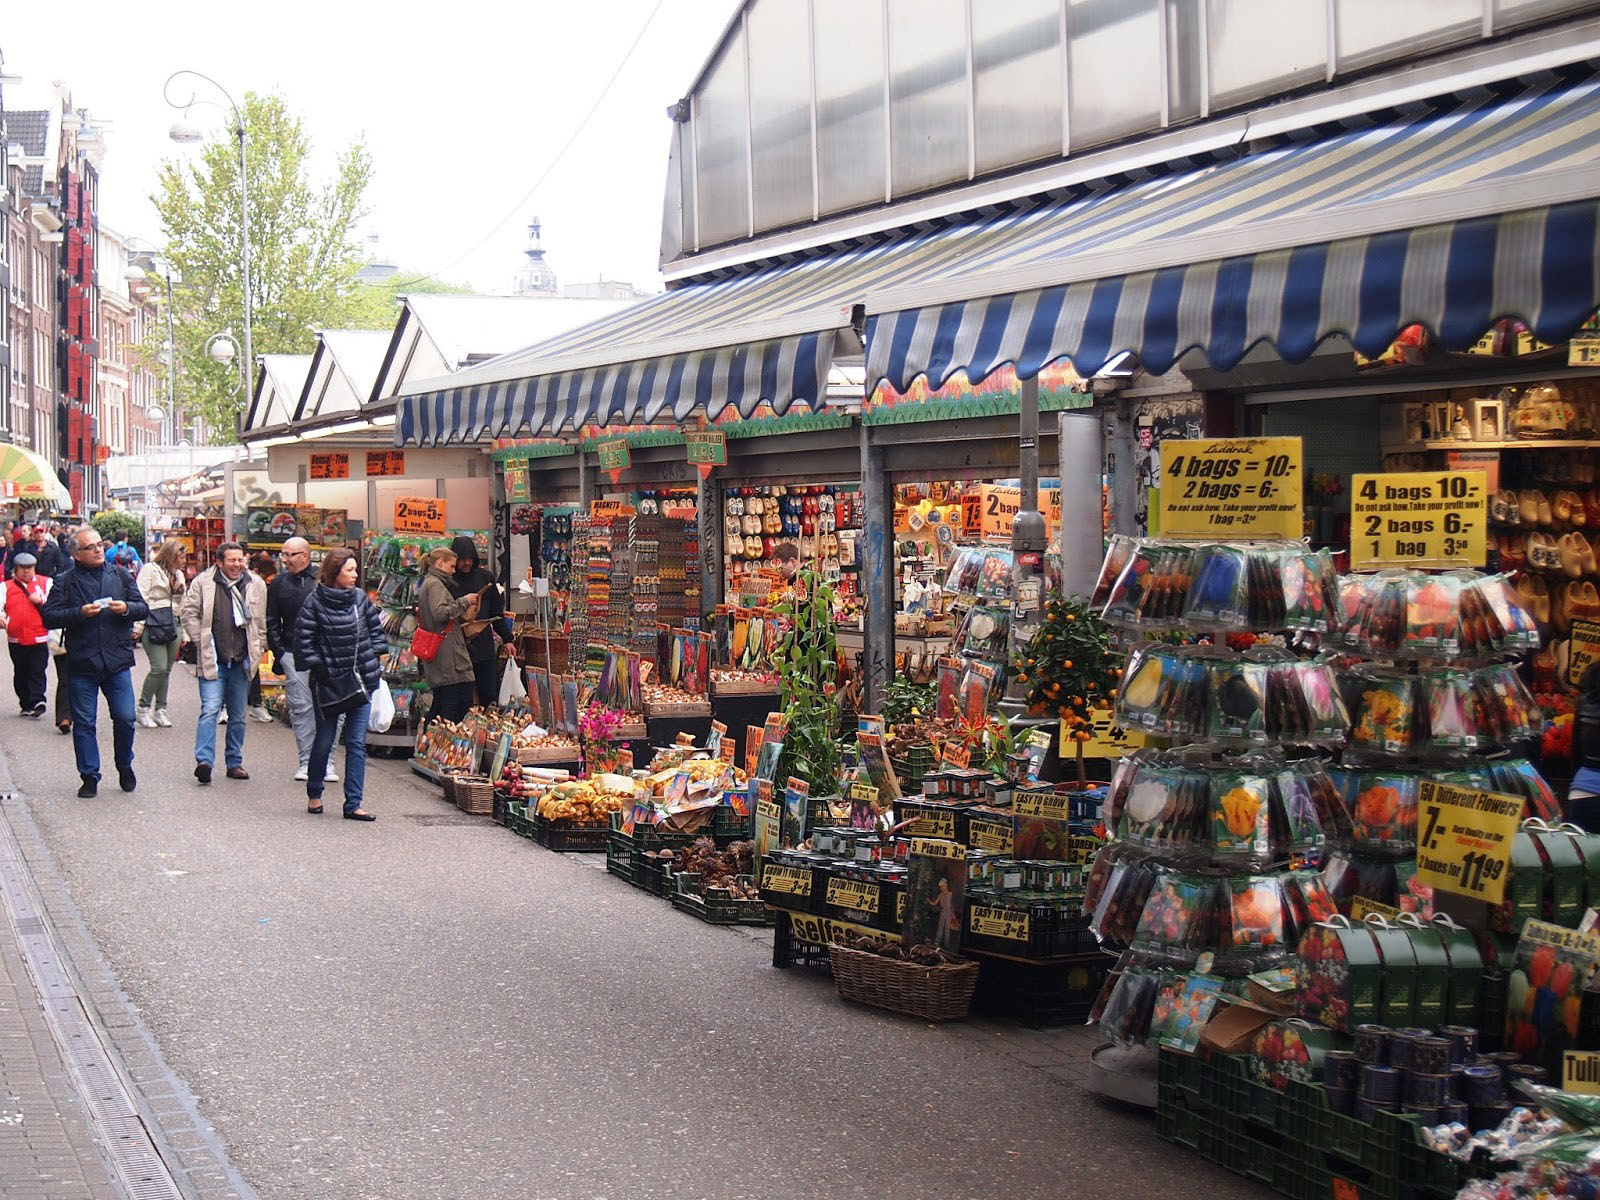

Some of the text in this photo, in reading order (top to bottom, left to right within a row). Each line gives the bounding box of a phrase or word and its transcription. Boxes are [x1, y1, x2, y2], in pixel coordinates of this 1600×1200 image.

[1168, 455, 1296, 479] 4 bags = 10.-
[1183, 481, 1196, 498] 2
[1197, 481, 1241, 500] bags
[1258, 481, 1278, 498] 6.-
[1360, 477, 1479, 500] 4 bags 10.-
[398, 503, 442, 520] 2 bags 5.-
[594, 501, 620, 509] MAGNETS
[987, 494, 1019, 516] 2 bag
[1257, 504, 1277, 512] profit
[1355, 503, 1364, 512] Do
[1366, 503, 1377, 512] not
[1379, 503, 1391, 511] ask
[1427, 502, 1443, 511] your
[1445, 501, 1464, 510] profit
[1465, 501, 1479, 509] now
[1215, 514, 1234, 525] bag
[1365, 513, 1473, 536] 2 bags 6.-
[1371, 538, 1468, 557] 1 bag 3.50
[1016, 793, 1065, 808] EASY TO GROW
[1421, 782, 1520, 817] 150 Different Flowers
[941, 812, 953, 822] SELF
[971, 822, 988, 833] GROW
[1421, 806, 1446, 849] 7.-
[912, 841, 917, 851] 5
[921, 842, 947, 856] Plants
[765, 866, 783, 877] GROW
[1418, 855, 1424, 868] 2
[1424, 857, 1448, 875] boxes
[1448, 861, 1461, 877] for
[830, 879, 847, 890] GROW
[853, 882, 866, 894] YOUR
[867, 886, 879, 896] SELF
[974, 907, 1026, 923] EASY TO GROW
